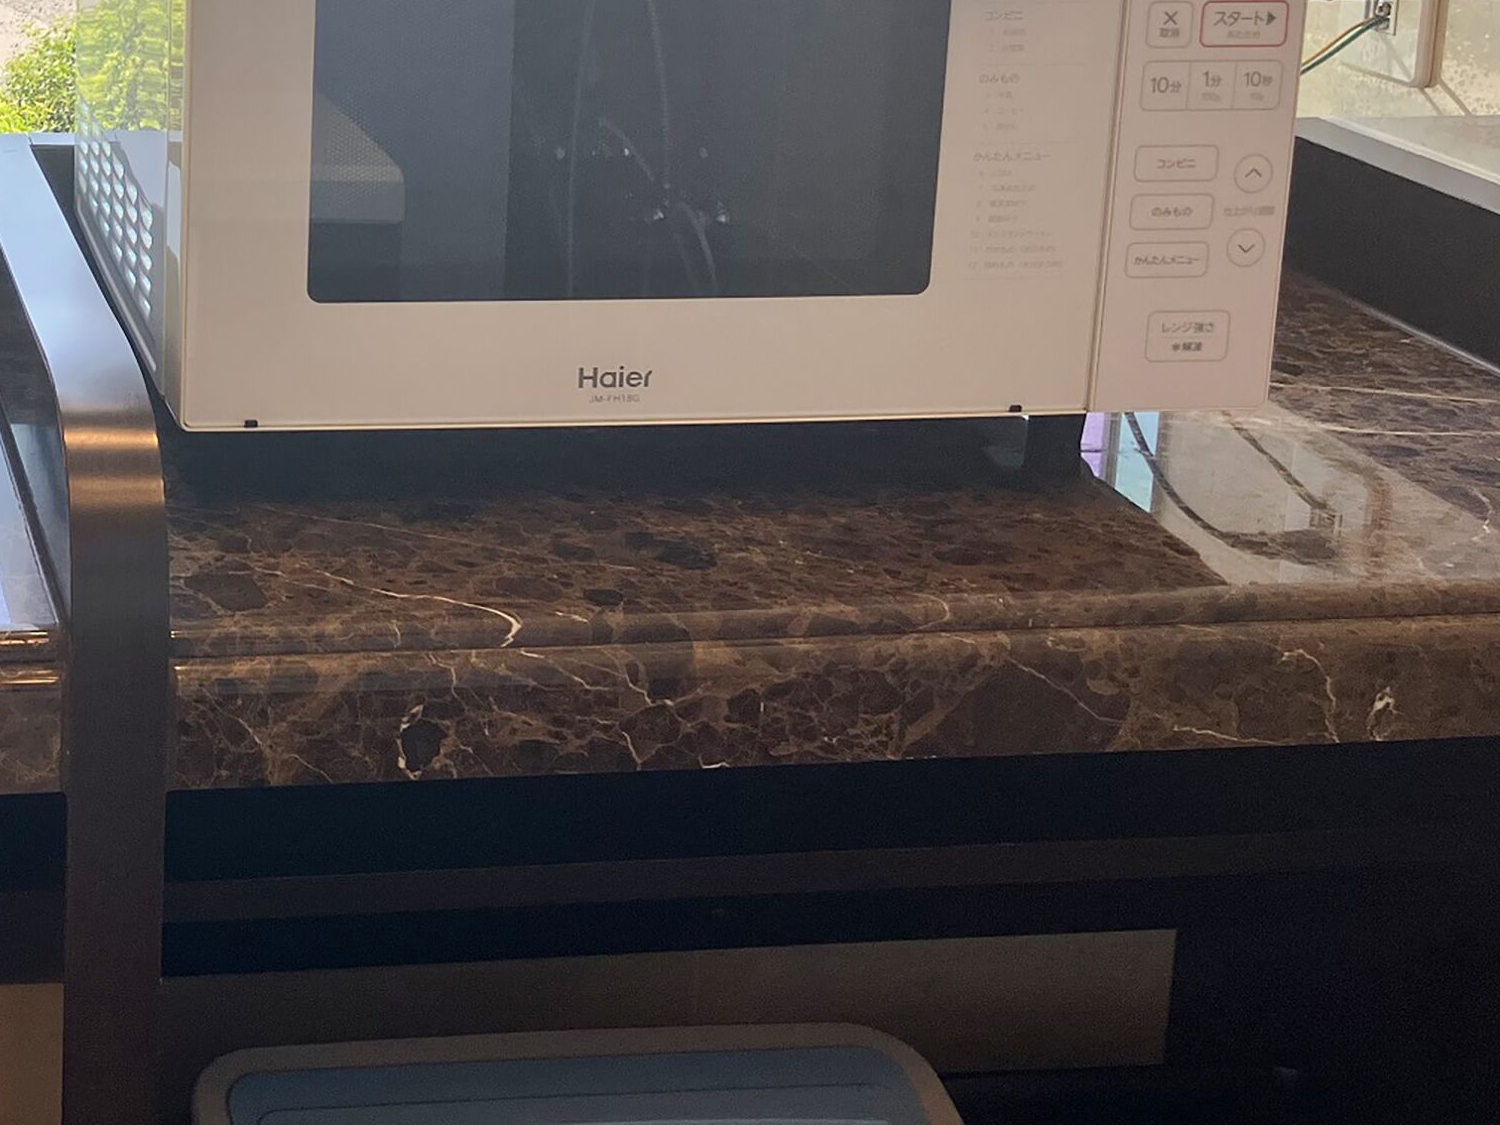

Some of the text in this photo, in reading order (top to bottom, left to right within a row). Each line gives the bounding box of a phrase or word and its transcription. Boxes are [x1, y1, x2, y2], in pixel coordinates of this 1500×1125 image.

[1213, 10, 1265, 26] スタート
[1150, 76, 1182, 94] 10分
[1203, 71, 1222, 88] 1分
[1156, 158, 1196, 169] コンビニ
[1151, 206, 1193, 217] のみもの
[1134, 255, 1201, 266] かんたんメニュー
[578, 365, 652, 388] Haier
